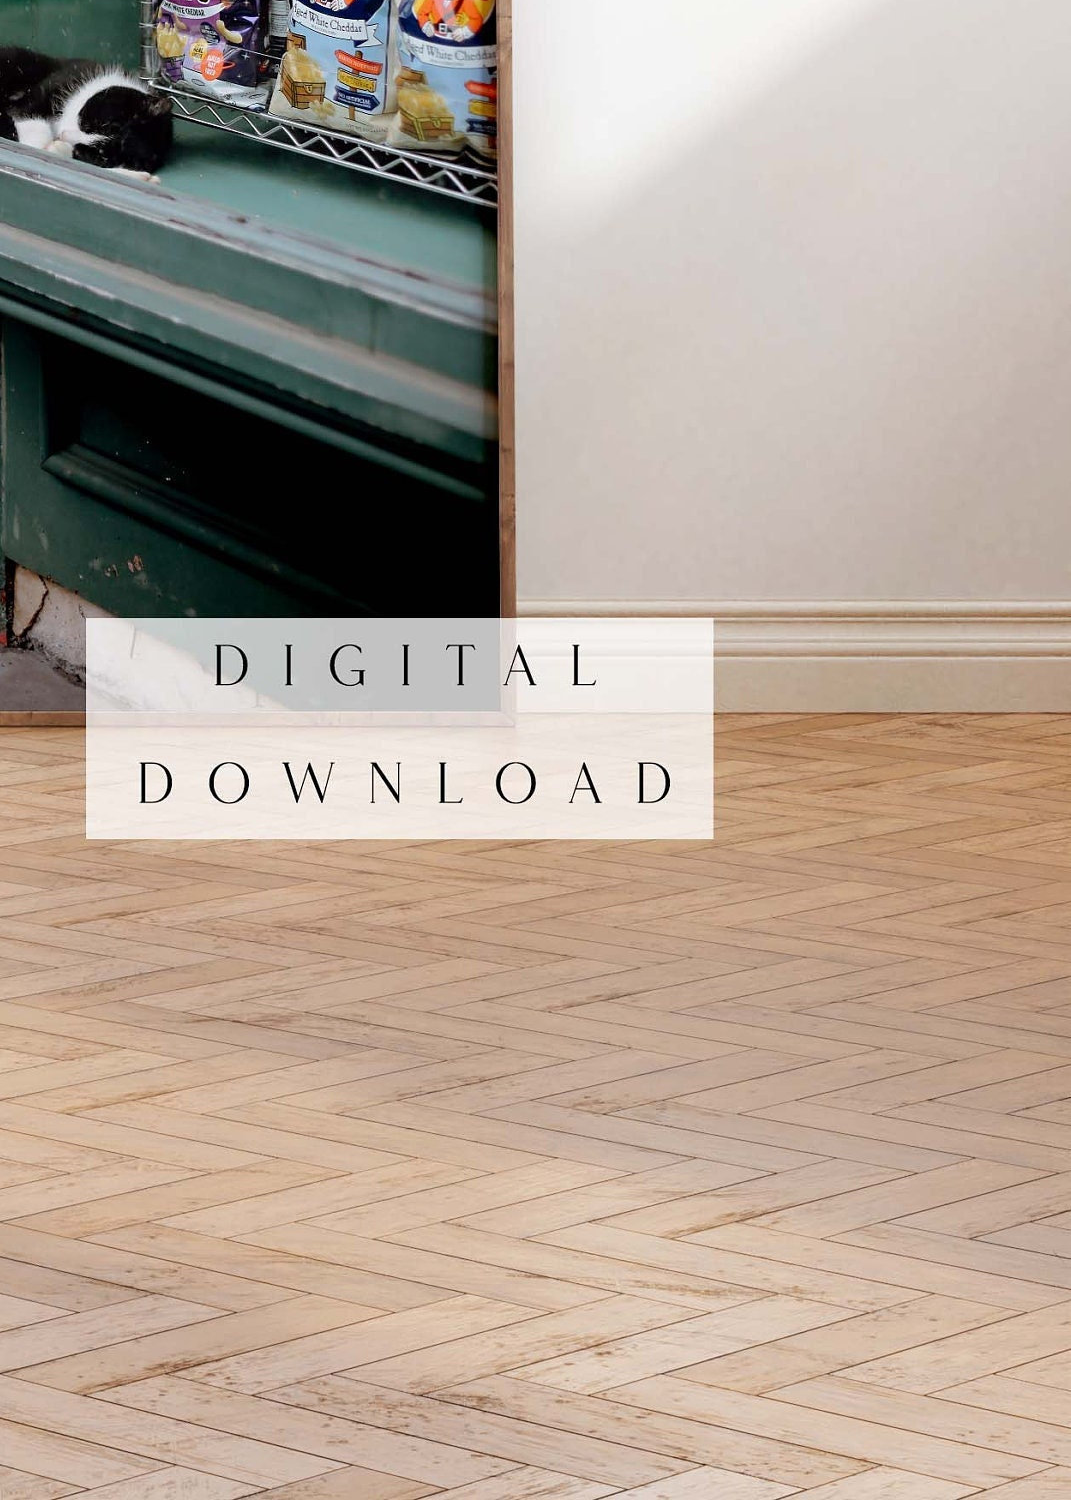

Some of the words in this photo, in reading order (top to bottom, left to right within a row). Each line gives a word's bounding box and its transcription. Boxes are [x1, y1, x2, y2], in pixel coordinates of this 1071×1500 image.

[309, 12, 328, 28] White
[330, 20, 362, 33] Cheddar
[425, 45, 451, 59] White
